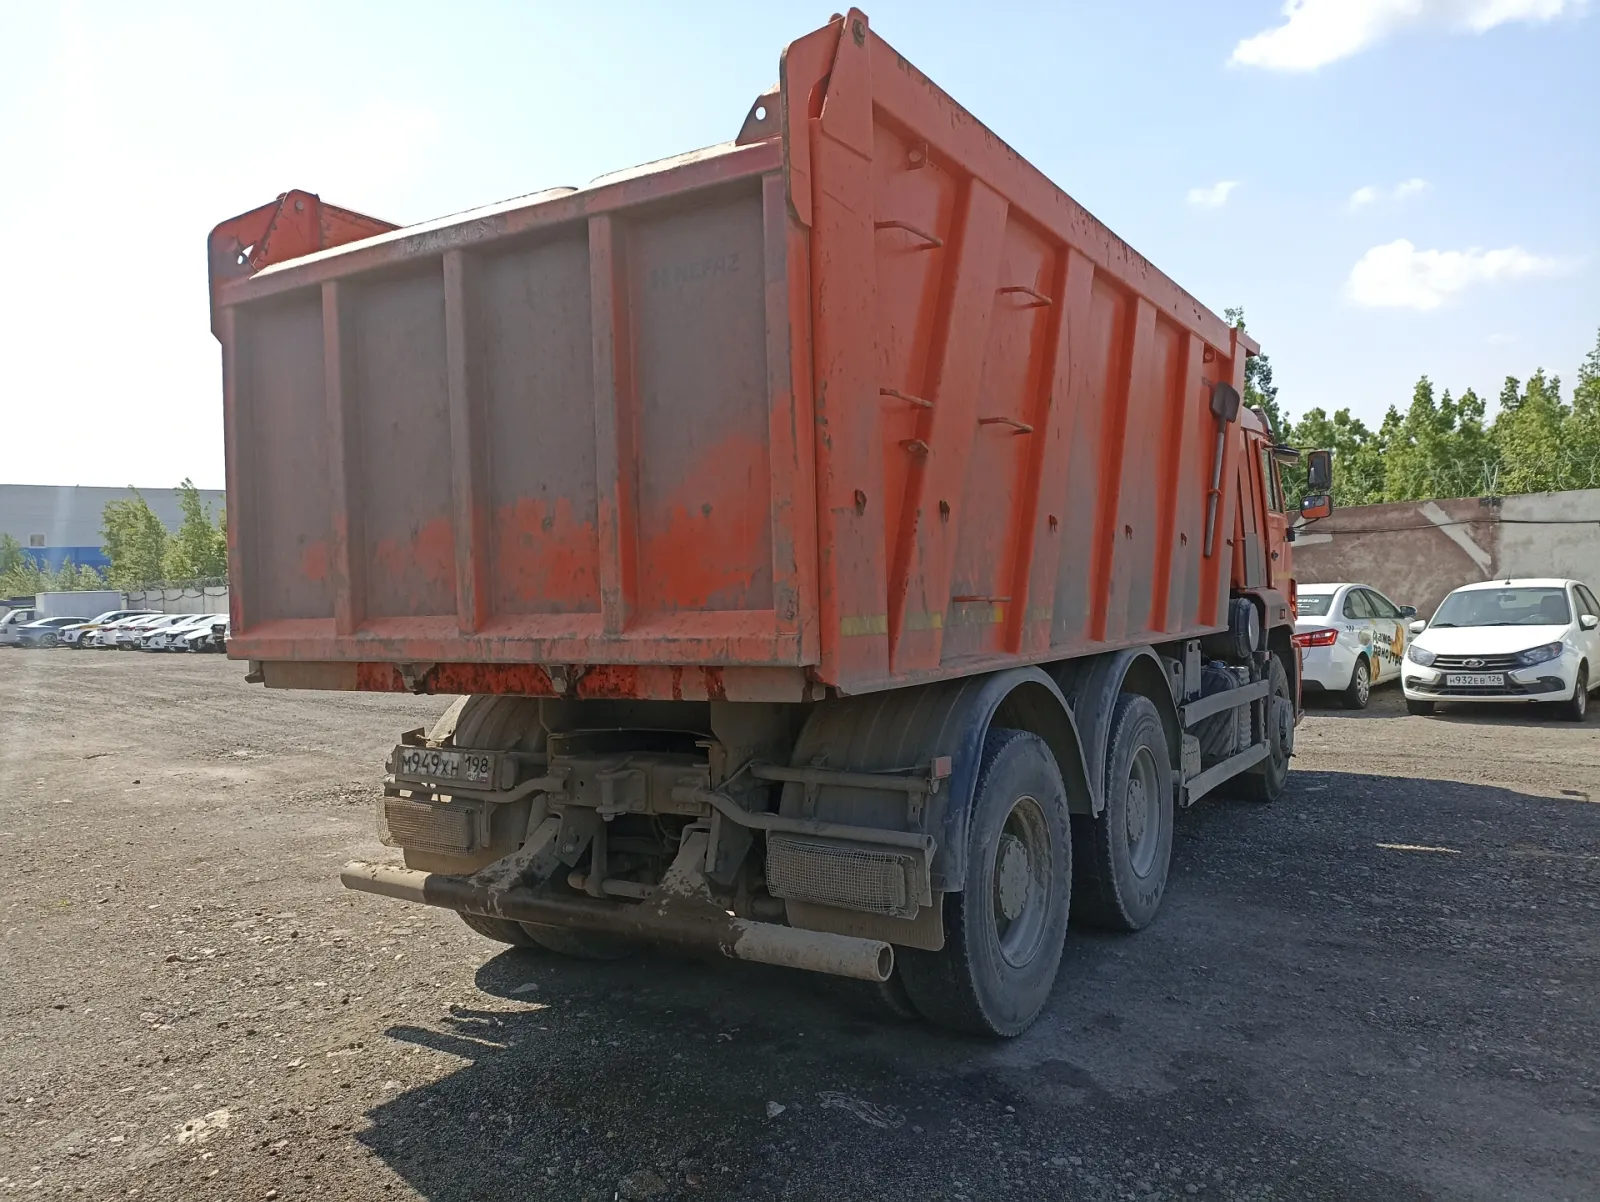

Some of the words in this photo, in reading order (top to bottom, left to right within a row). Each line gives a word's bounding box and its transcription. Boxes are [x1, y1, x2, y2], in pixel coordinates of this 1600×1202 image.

[1388, 651, 1402, 666] утро
[402, 752, 460, 776] М949ХН
[464, 755, 489, 774] 198
